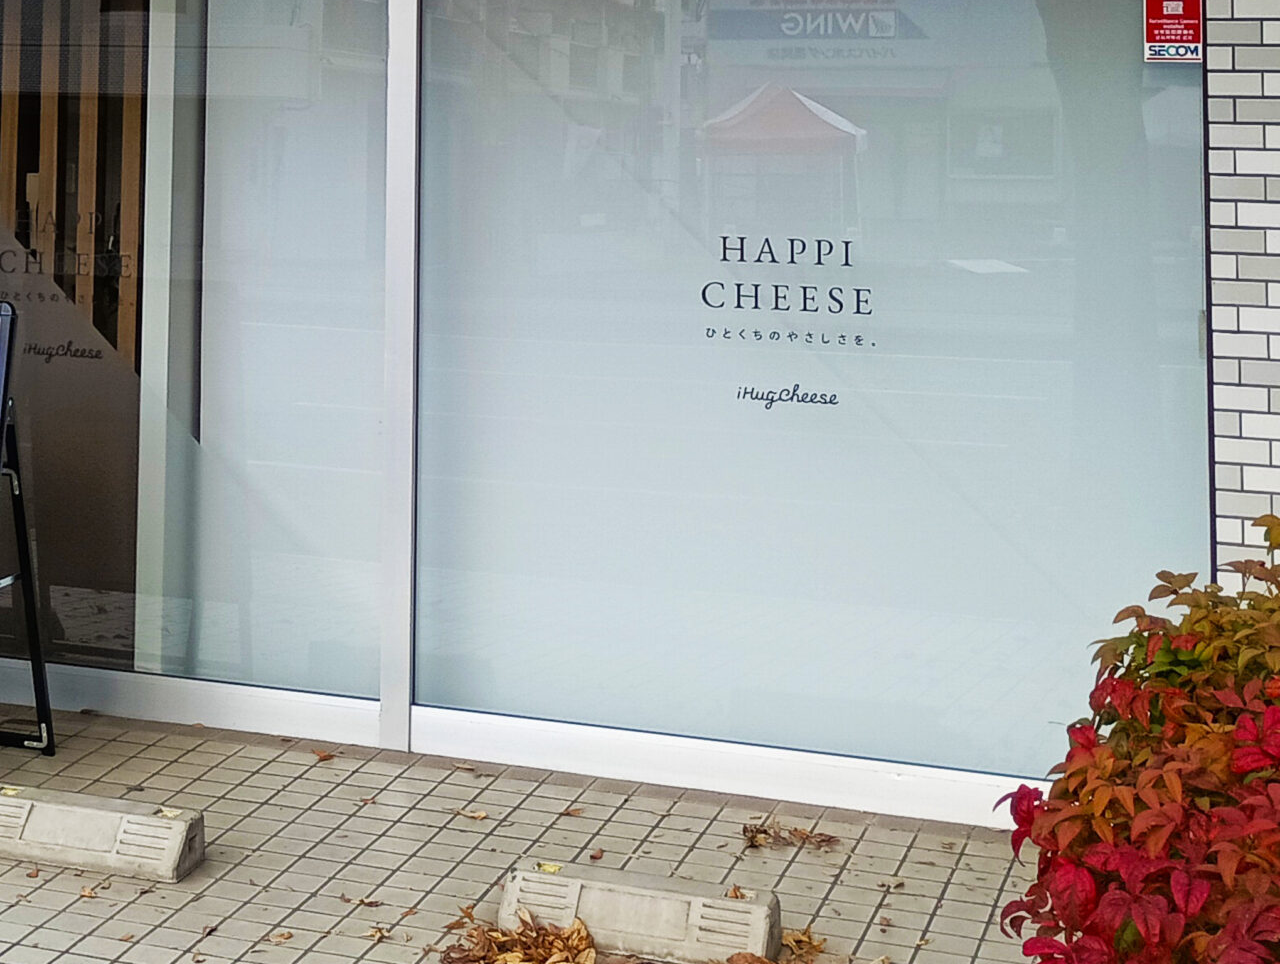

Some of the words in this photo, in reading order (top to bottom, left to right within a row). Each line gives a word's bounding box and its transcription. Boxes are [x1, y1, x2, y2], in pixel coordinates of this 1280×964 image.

[1148, 44, 1199, 57] SECOM
[16, 209, 119, 235] HAPP
[719, 235, 854, 268] HAPPI
[701, 281, 873, 315] CHEESE
[705, 327, 876, 347] ひとくちのやさしさを。
